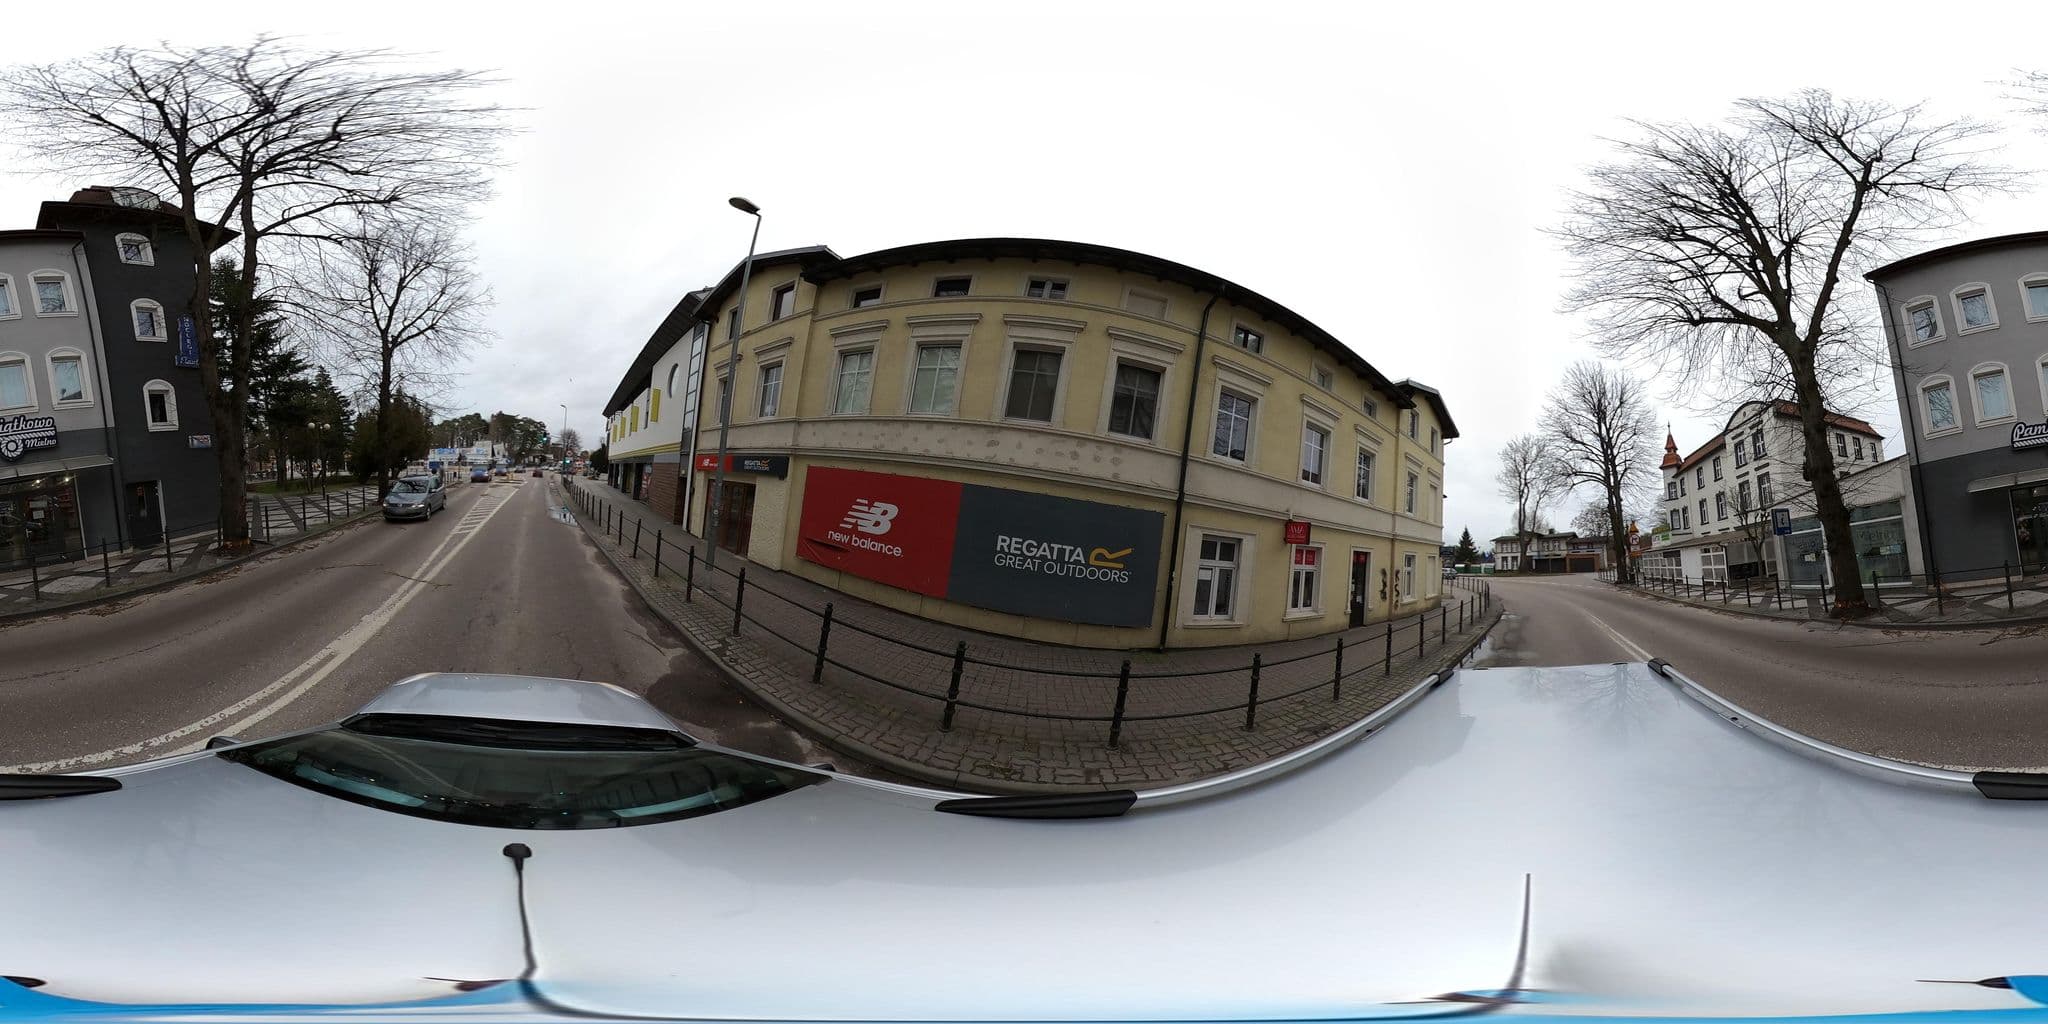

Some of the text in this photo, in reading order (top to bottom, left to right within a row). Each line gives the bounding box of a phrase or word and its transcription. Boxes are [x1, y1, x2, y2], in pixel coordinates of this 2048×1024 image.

[25, 438, 57, 448] Mielno
[827, 530, 902, 557] new balance
[996, 535, 1086, 564] REGATTA
[994, 553, 1129, 583] GREAT OUTDOORS
